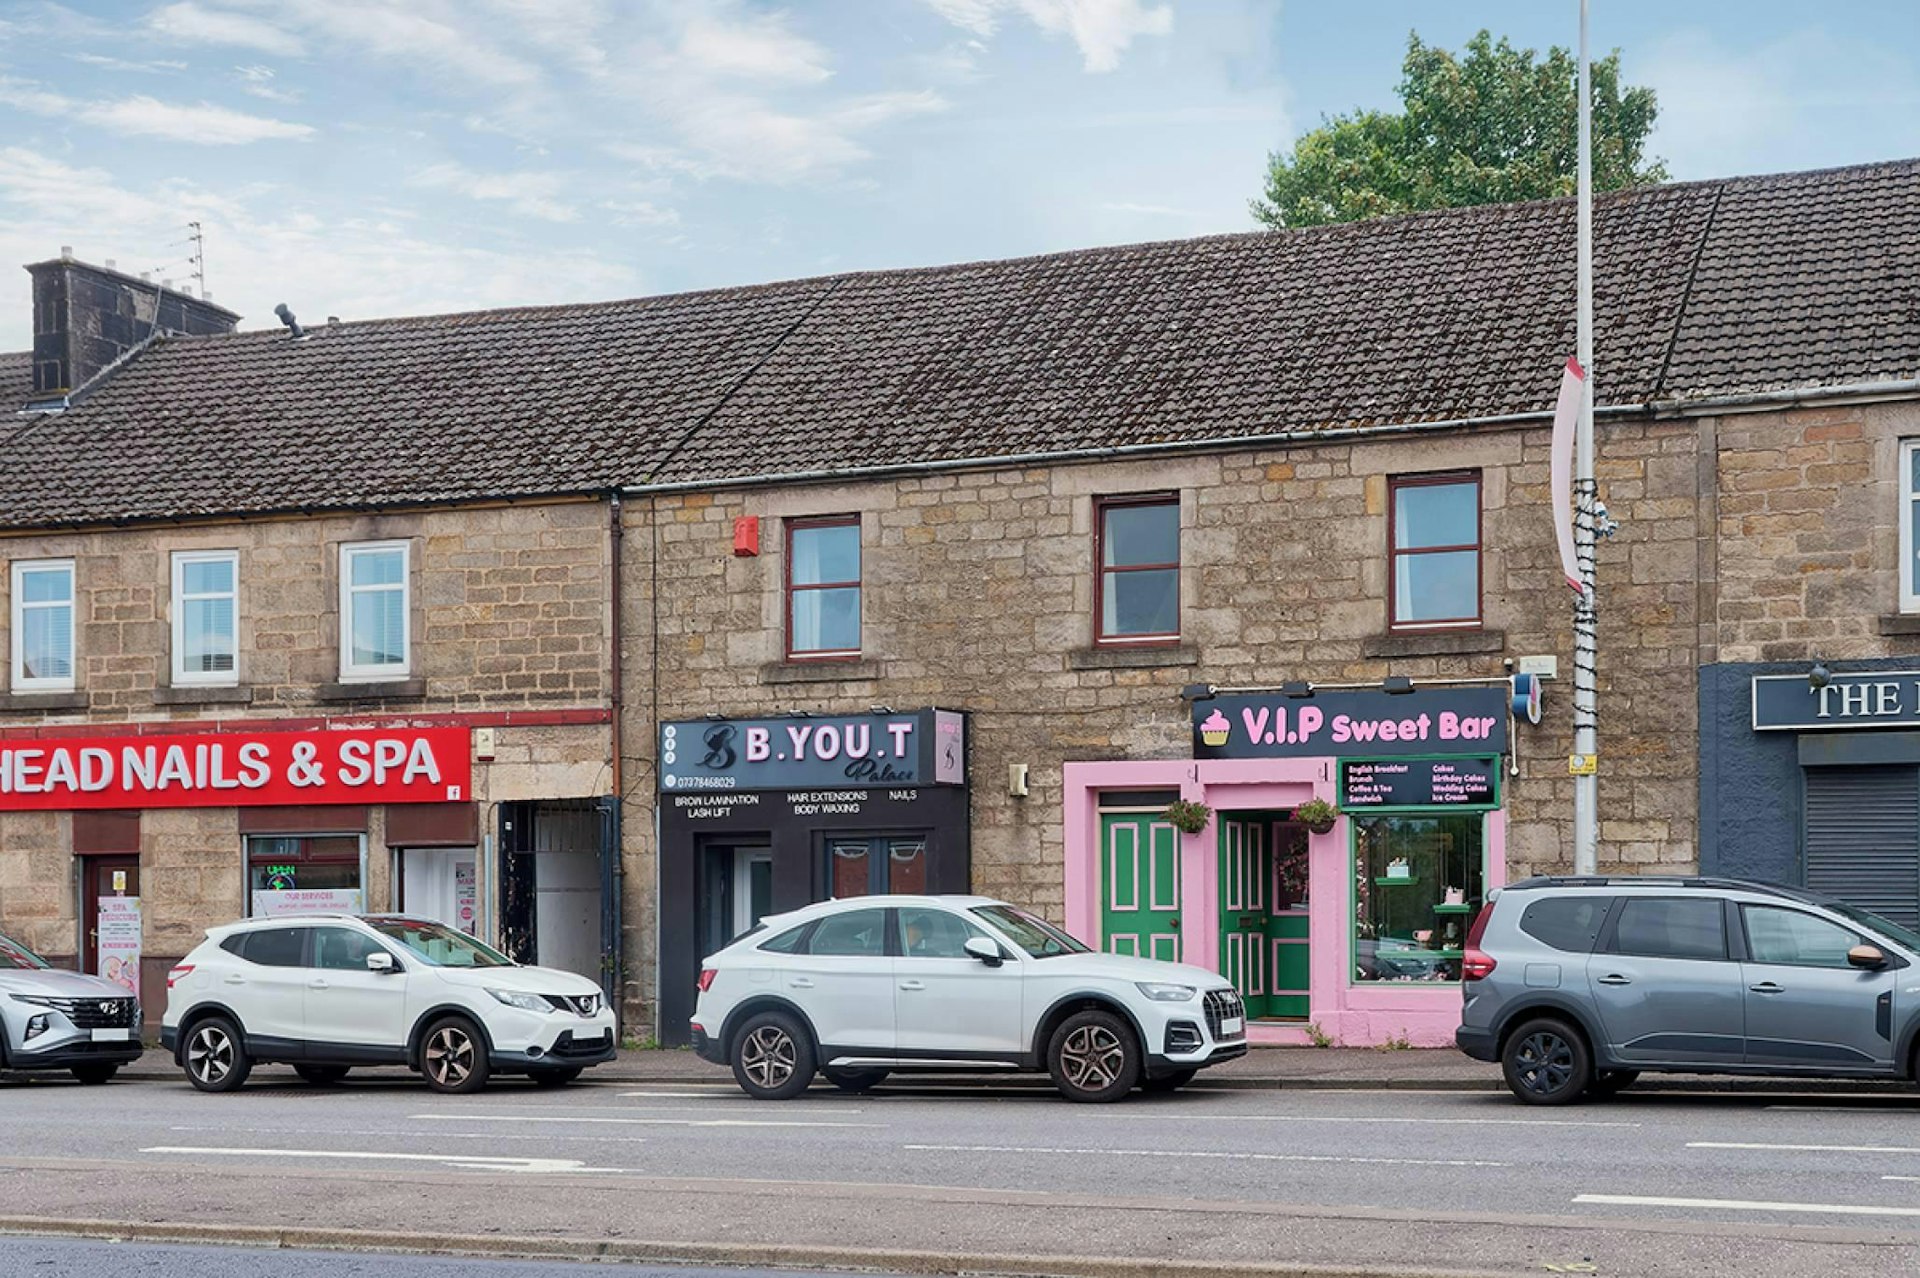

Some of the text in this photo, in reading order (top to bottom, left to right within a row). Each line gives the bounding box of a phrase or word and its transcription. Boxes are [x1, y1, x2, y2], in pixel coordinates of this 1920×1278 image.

[1809, 682, 1903, 718] THE
[1242, 706, 1496, 744] V.I.P Sweet Bar
[746, 723, 913, 762] B.YOU.T
[122, 742, 272, 791] NAILS
[287, 740, 326, 787] &
[338, 738, 441, 786] SPA
[1348, 764, 1409, 775] English Breakfast
[1432, 764, 1455, 773] Cakes
[1348, 775, 1374, 783] Brunch
[1432, 774, 1486, 784] Birthday Cakes
[888, 789, 918, 801] NAILS
[1348, 785, 1393, 793] Coffee & Tea
[1432, 784, 1488, 794] Wedding Cakes
[674, 794, 759, 807] BROW LAMINATION
[787, 790, 868, 803] HAIR EXTENSIONS
[1348, 794, 1383, 803] Sandwich
[1432, 793, 1469, 802] Ice Cream
[687, 807, 731, 819] LASH LIFT
[794, 803, 860, 815] BODY WAXING
